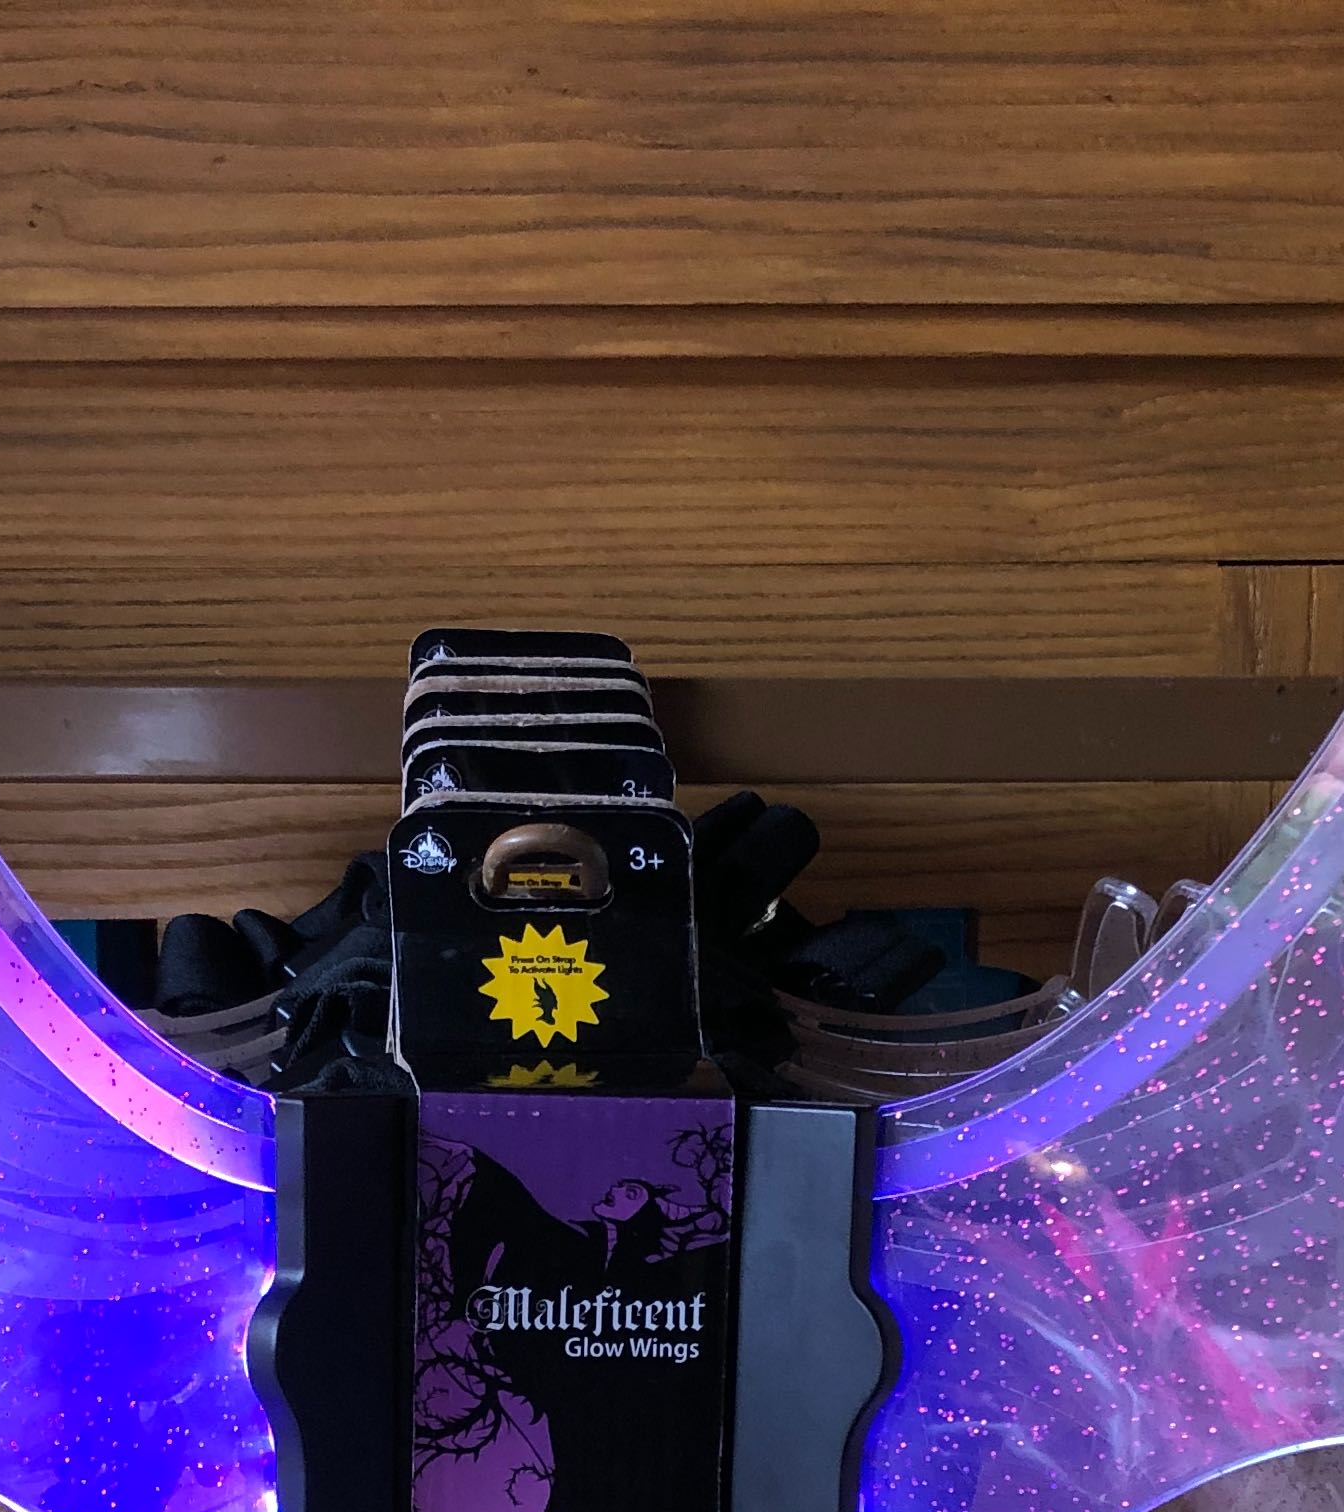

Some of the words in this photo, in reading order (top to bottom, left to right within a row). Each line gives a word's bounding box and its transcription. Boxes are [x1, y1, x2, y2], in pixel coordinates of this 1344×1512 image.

[629, 847, 665, 871] 3+
[509, 966, 519, 974] To
[511, 956, 535, 964] Press
[536, 955, 551, 964] On
[466, 1285, 706, 1337] Maleficent
[565, 1337, 624, 1358] Glow
[630, 1337, 700, 1363] Wings
